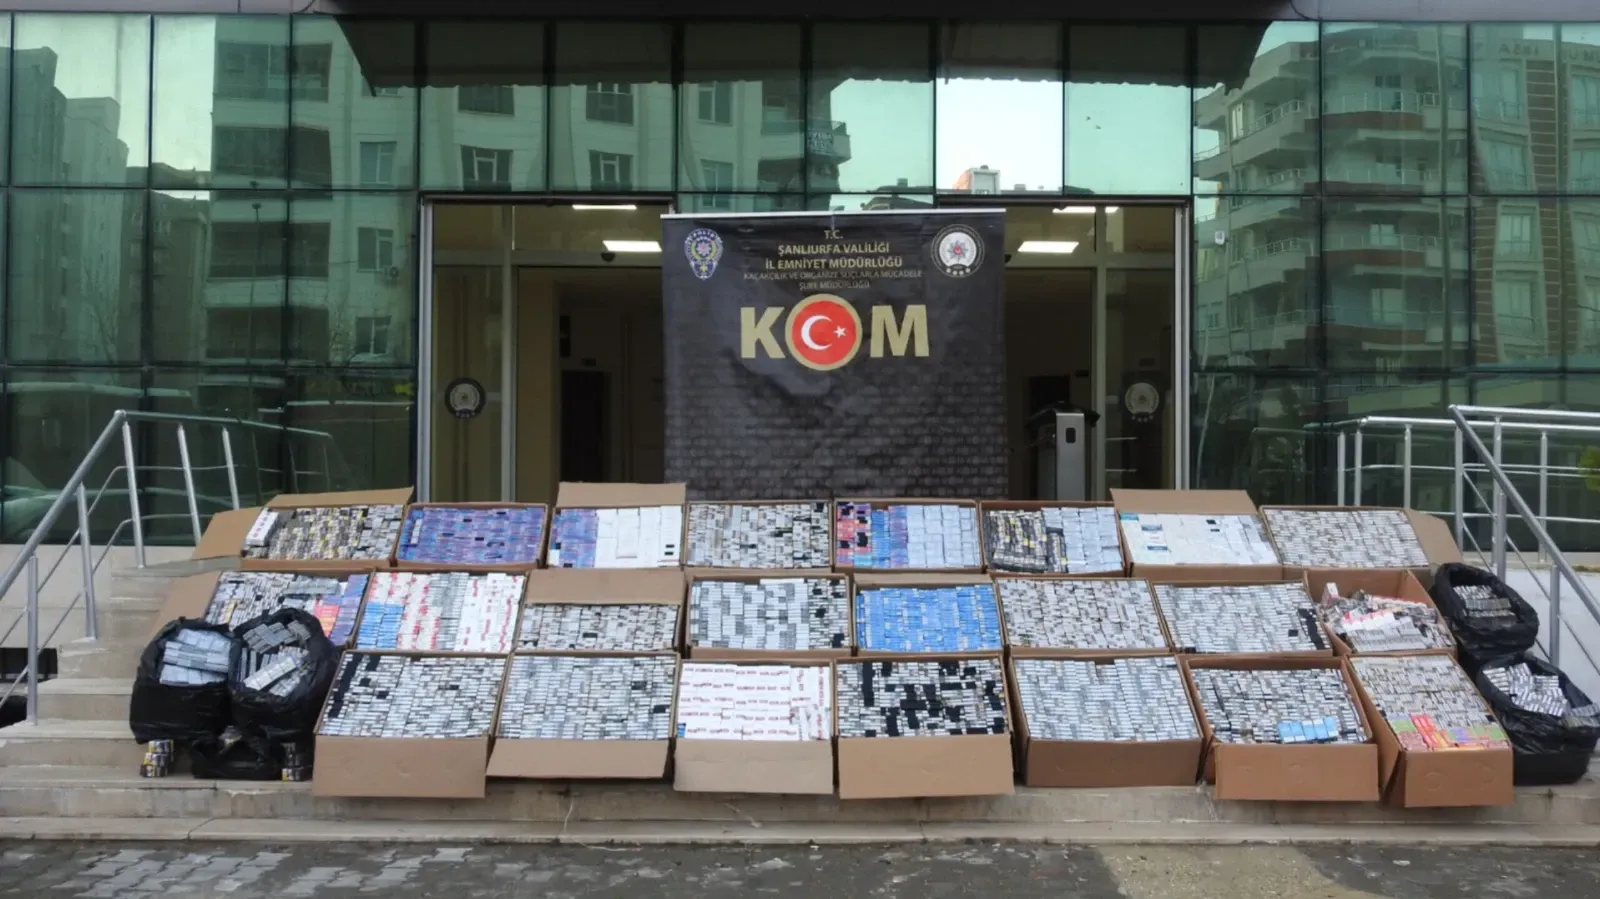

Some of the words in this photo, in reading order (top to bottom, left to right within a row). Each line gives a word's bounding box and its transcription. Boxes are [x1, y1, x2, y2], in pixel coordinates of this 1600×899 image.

[823, 230, 844, 240] T.C.
[778, 244, 840, 257] ŞANLIURFA
[765, 257, 776, 270] İL
[778, 257, 826, 270] EMNİYET
[829, 255, 903, 269] MÜDÜRLÜĞÜ
